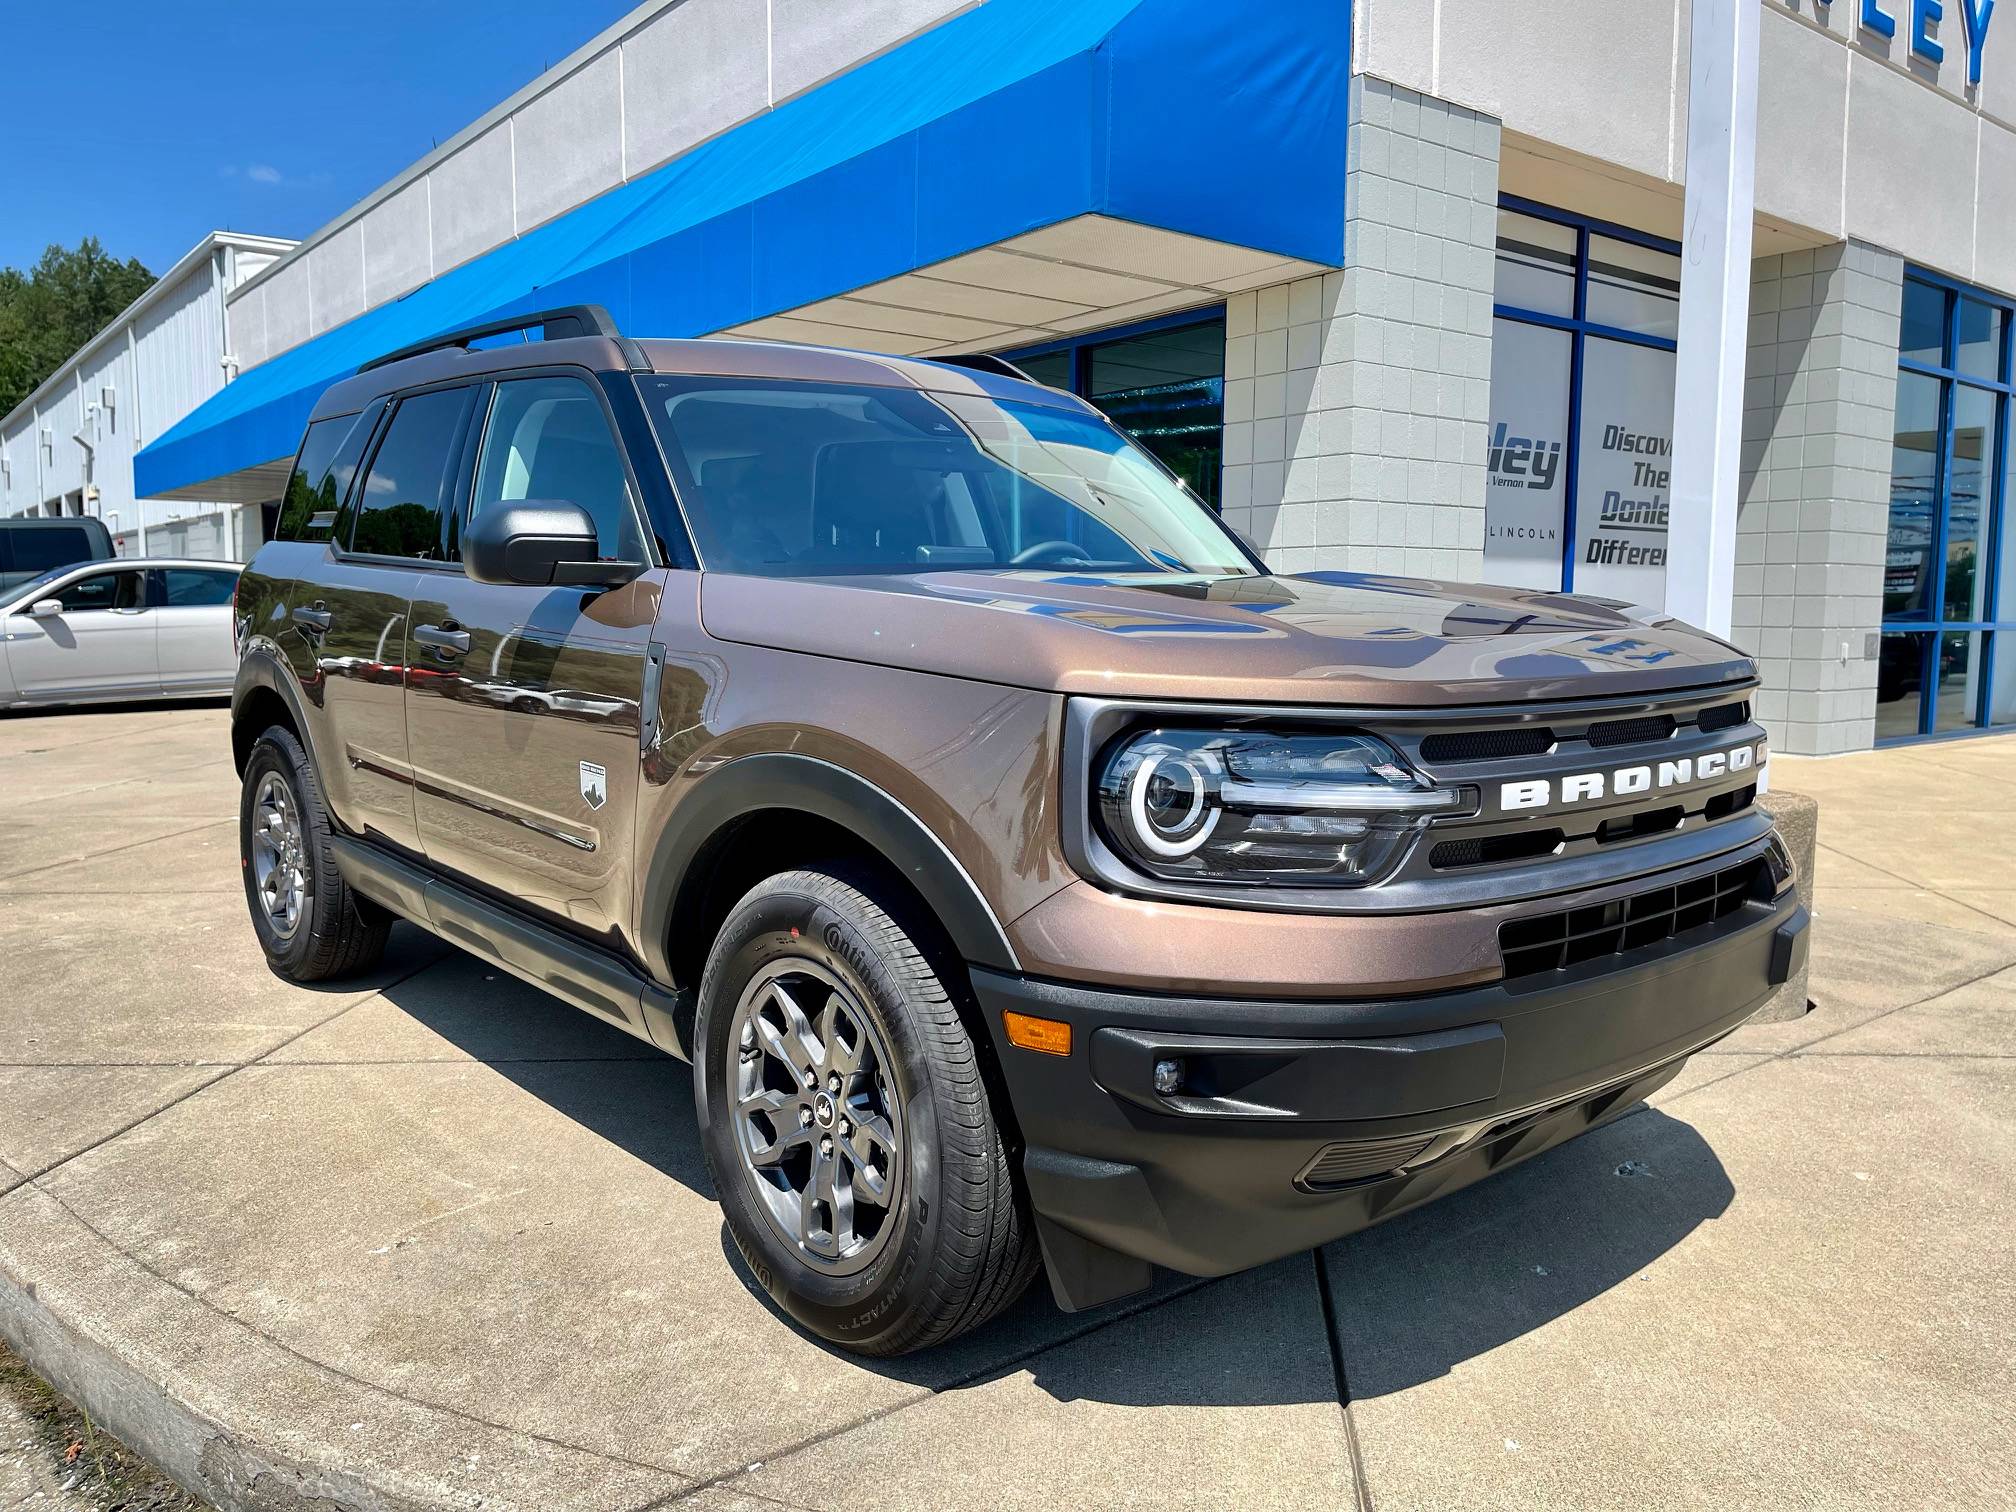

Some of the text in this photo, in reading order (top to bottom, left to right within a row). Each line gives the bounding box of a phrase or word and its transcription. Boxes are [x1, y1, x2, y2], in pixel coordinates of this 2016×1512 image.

[1603, 424, 1672, 457] Discov
[1488, 423, 1560, 490] ley
[1492, 475, 1524, 489] Vernon
[1633, 462, 1669, 488] The
[1600, 490, 1669, 525] Donle
[1490, 526, 1555, 540] LINCOLN
[1586, 538, 1667, 566] Differe
[1500, 745, 1752, 811] BRONCO
